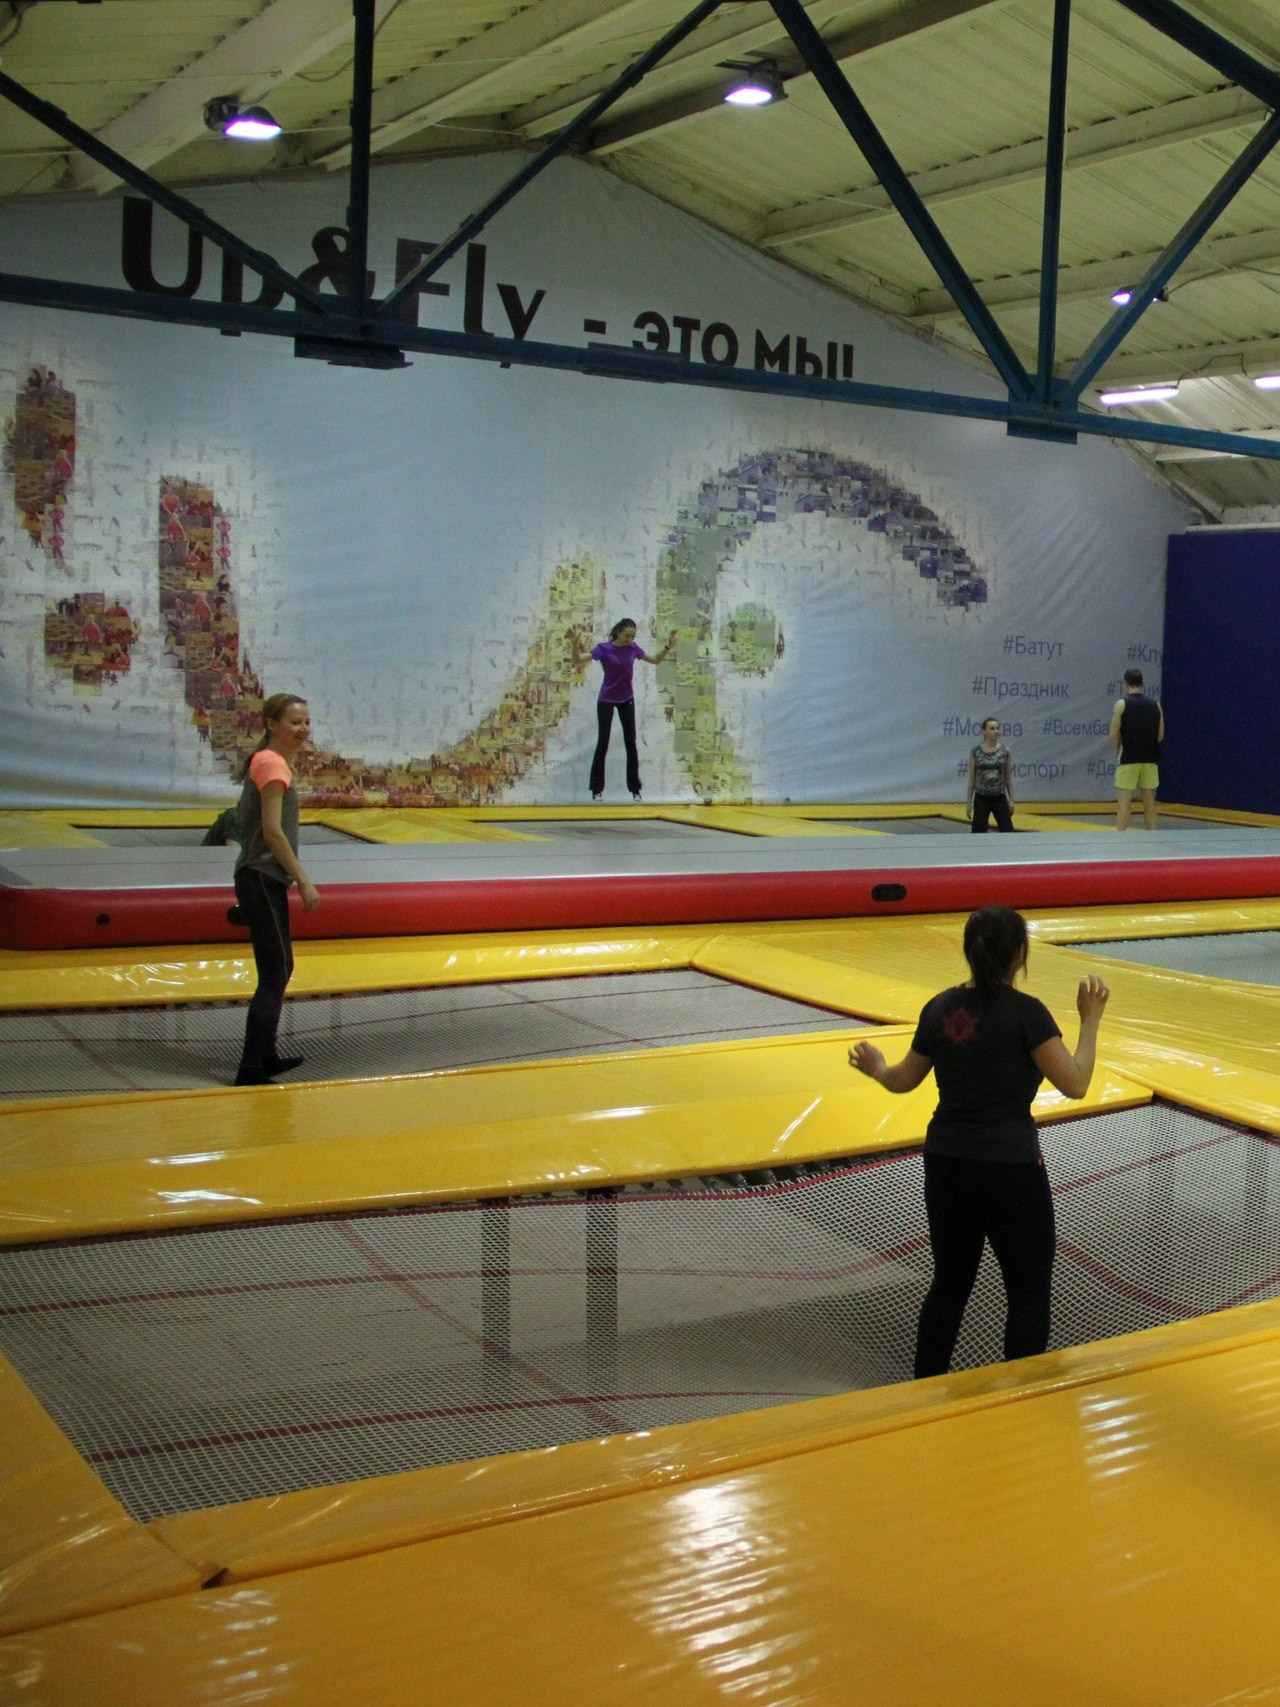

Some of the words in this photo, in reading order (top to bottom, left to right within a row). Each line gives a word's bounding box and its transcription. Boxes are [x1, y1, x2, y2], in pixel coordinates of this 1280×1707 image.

[1003, 635, 1065, 661] #Батут
[971, 676, 1070, 701] #Праздник
[943, 717, 1023, 738] #Мова
